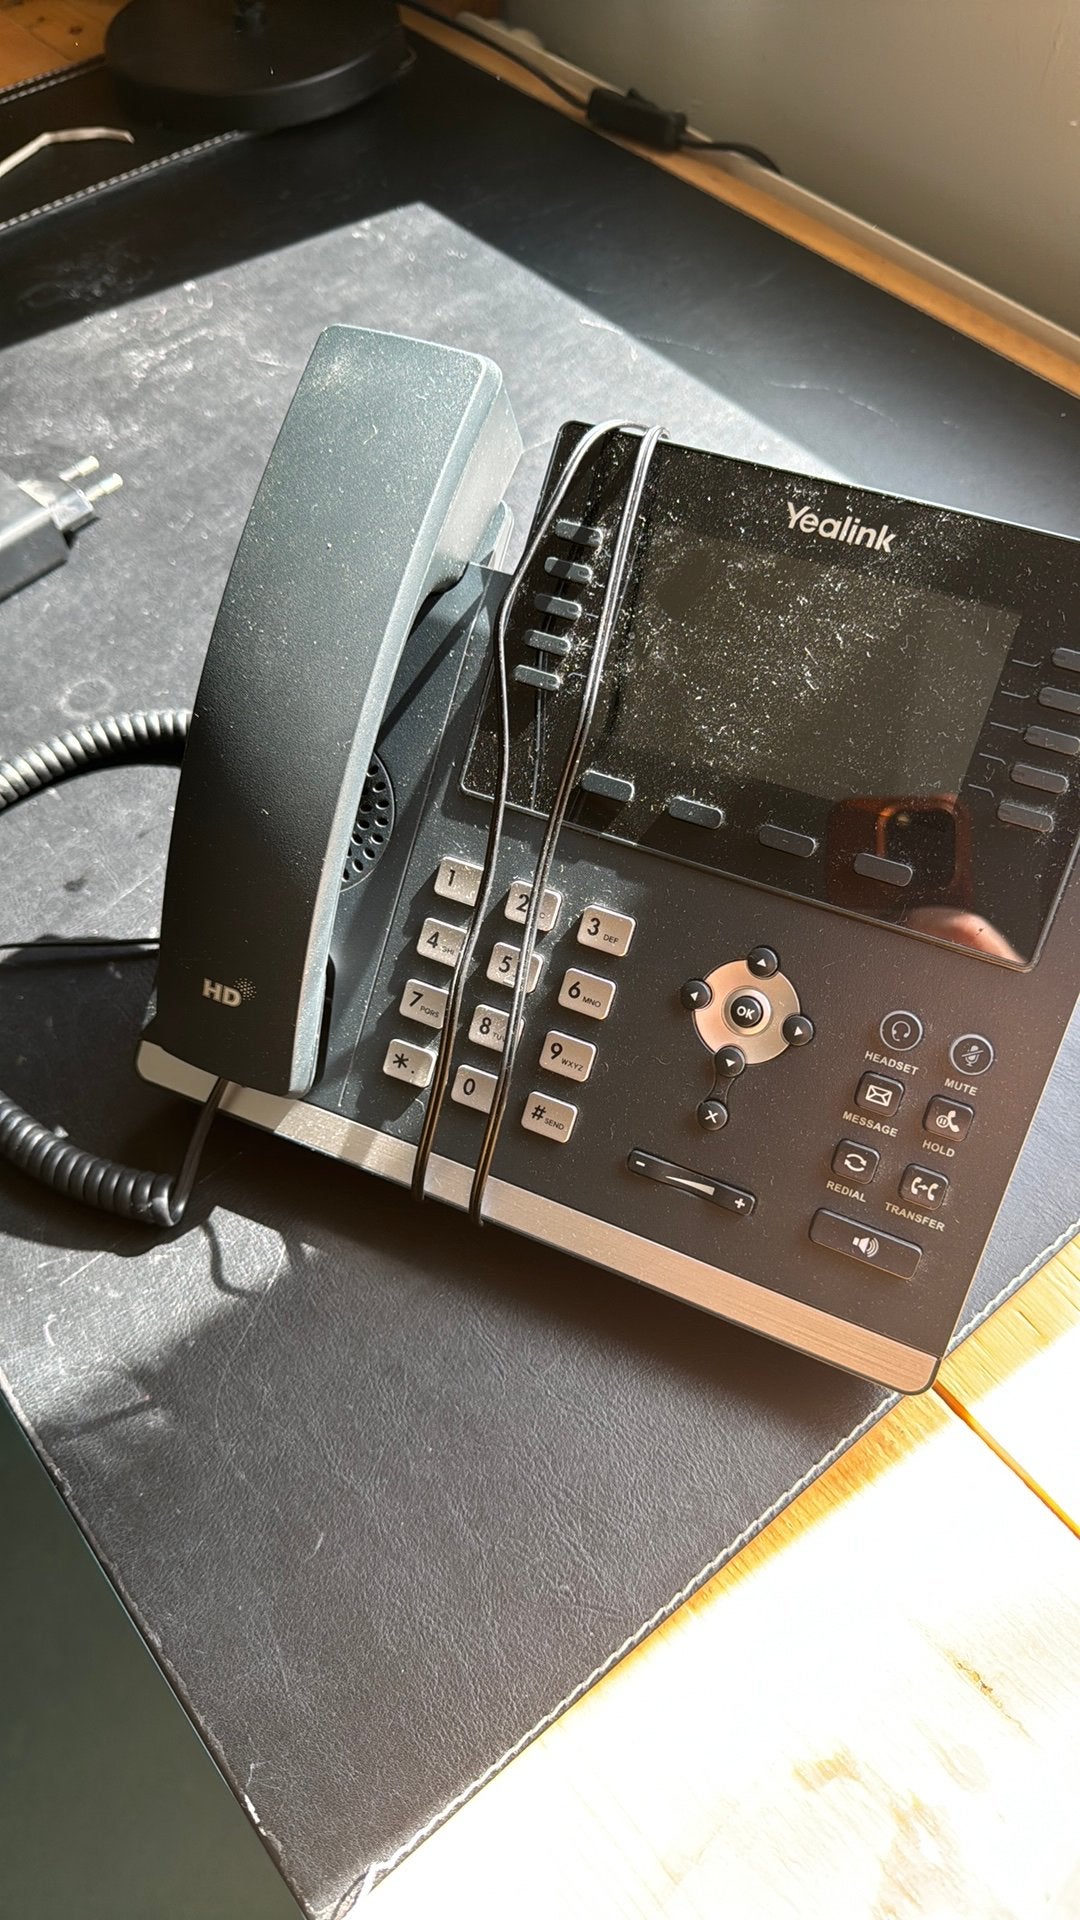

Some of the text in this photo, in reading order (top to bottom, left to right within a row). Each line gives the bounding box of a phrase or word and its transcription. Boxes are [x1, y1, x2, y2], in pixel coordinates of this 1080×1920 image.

[787, 501, 897, 553] Yealink
[448, 869, 456, 887] 1
[516, 894, 529, 912] 2
[427, 931, 439, 949] 4
[587, 917, 619, 944] 3 DEF
[498, 955, 512, 973] 5
[202, 978, 242, 1007] HD
[568, 981, 601, 1008] 6 MNO
[410, 991, 439, 1019] 7 PQRS
[736, 1005, 755, 1019] OK
[480, 1017, 491, 1034] 8
[550, 1042, 583, 1072] 9 WXYZ
[864, 1050, 919, 1076] HEADSET
[463, 1078, 475, 1096] 0
[944, 1078, 978, 1097] MUTE
[544, 1119, 565, 1131] SEND
[842, 1111, 899, 1137] MESSAGE
[922, 1139, 956, 1158] HOLD
[826, 1180, 867, 1203] REDIAL
[885, 1202, 946, 1232] TRANSFER
